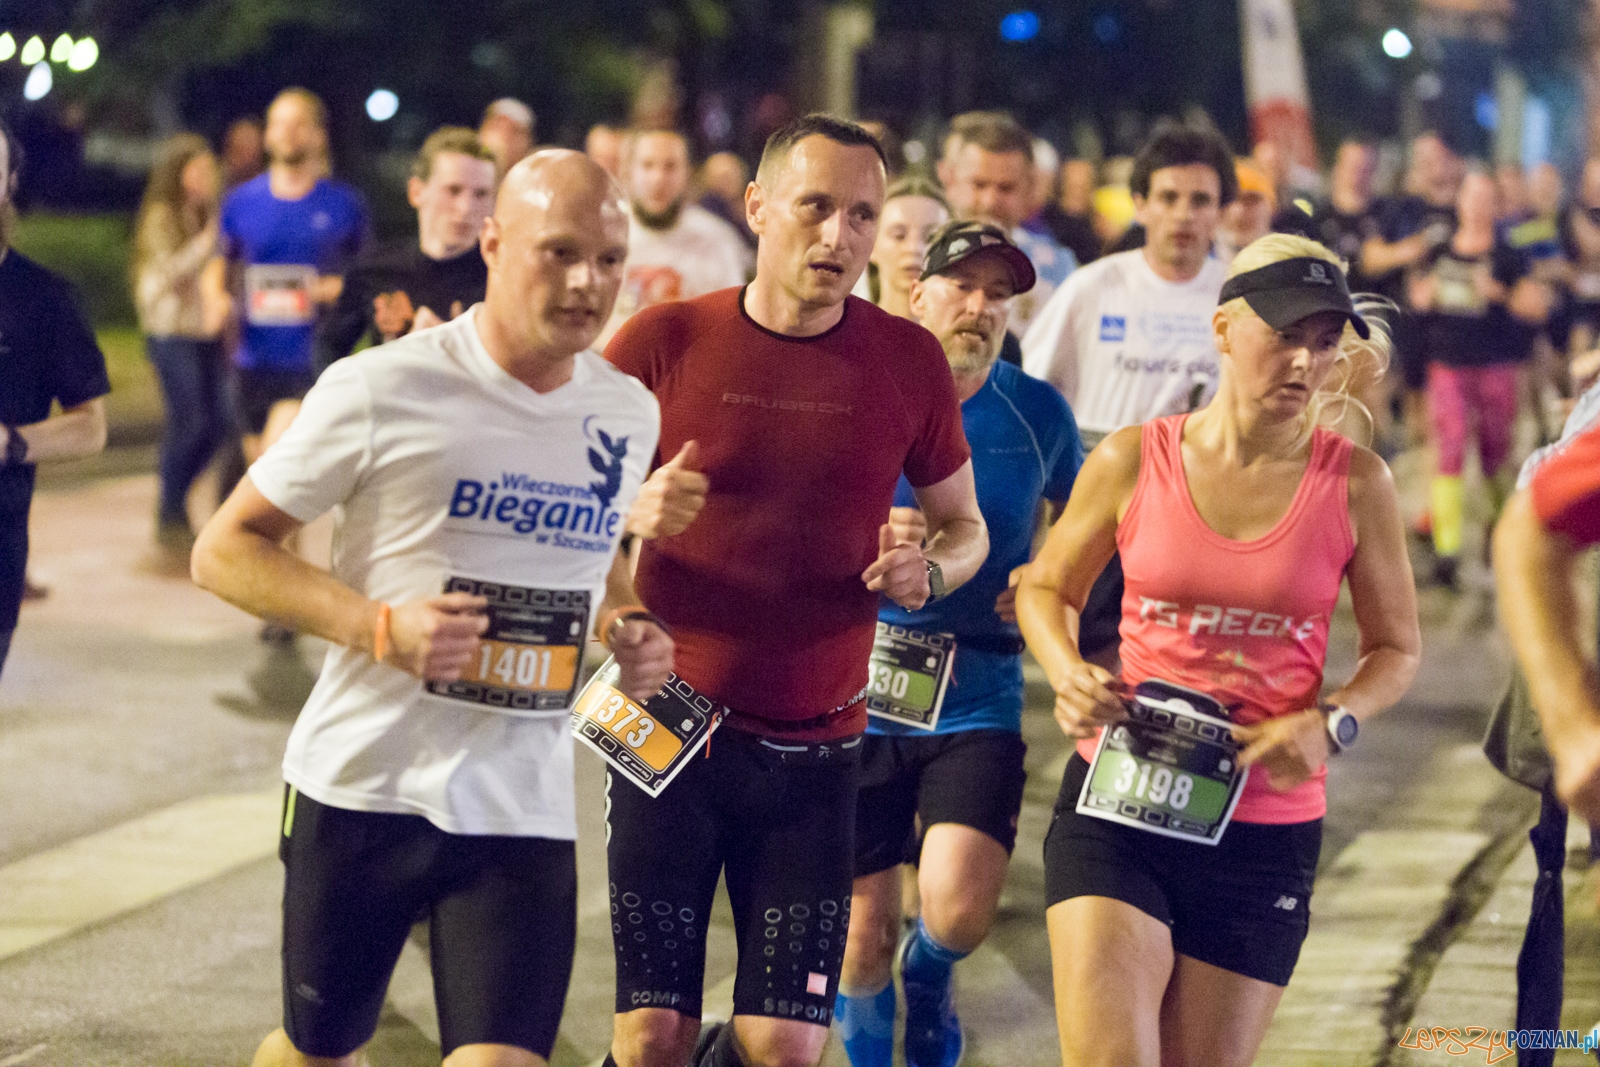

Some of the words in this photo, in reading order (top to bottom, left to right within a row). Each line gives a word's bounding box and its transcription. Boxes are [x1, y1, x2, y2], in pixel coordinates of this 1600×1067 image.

[479, 646, 551, 686] 1401
[589, 689, 655, 749] 1373
[1113, 757, 1194, 810] 3198
